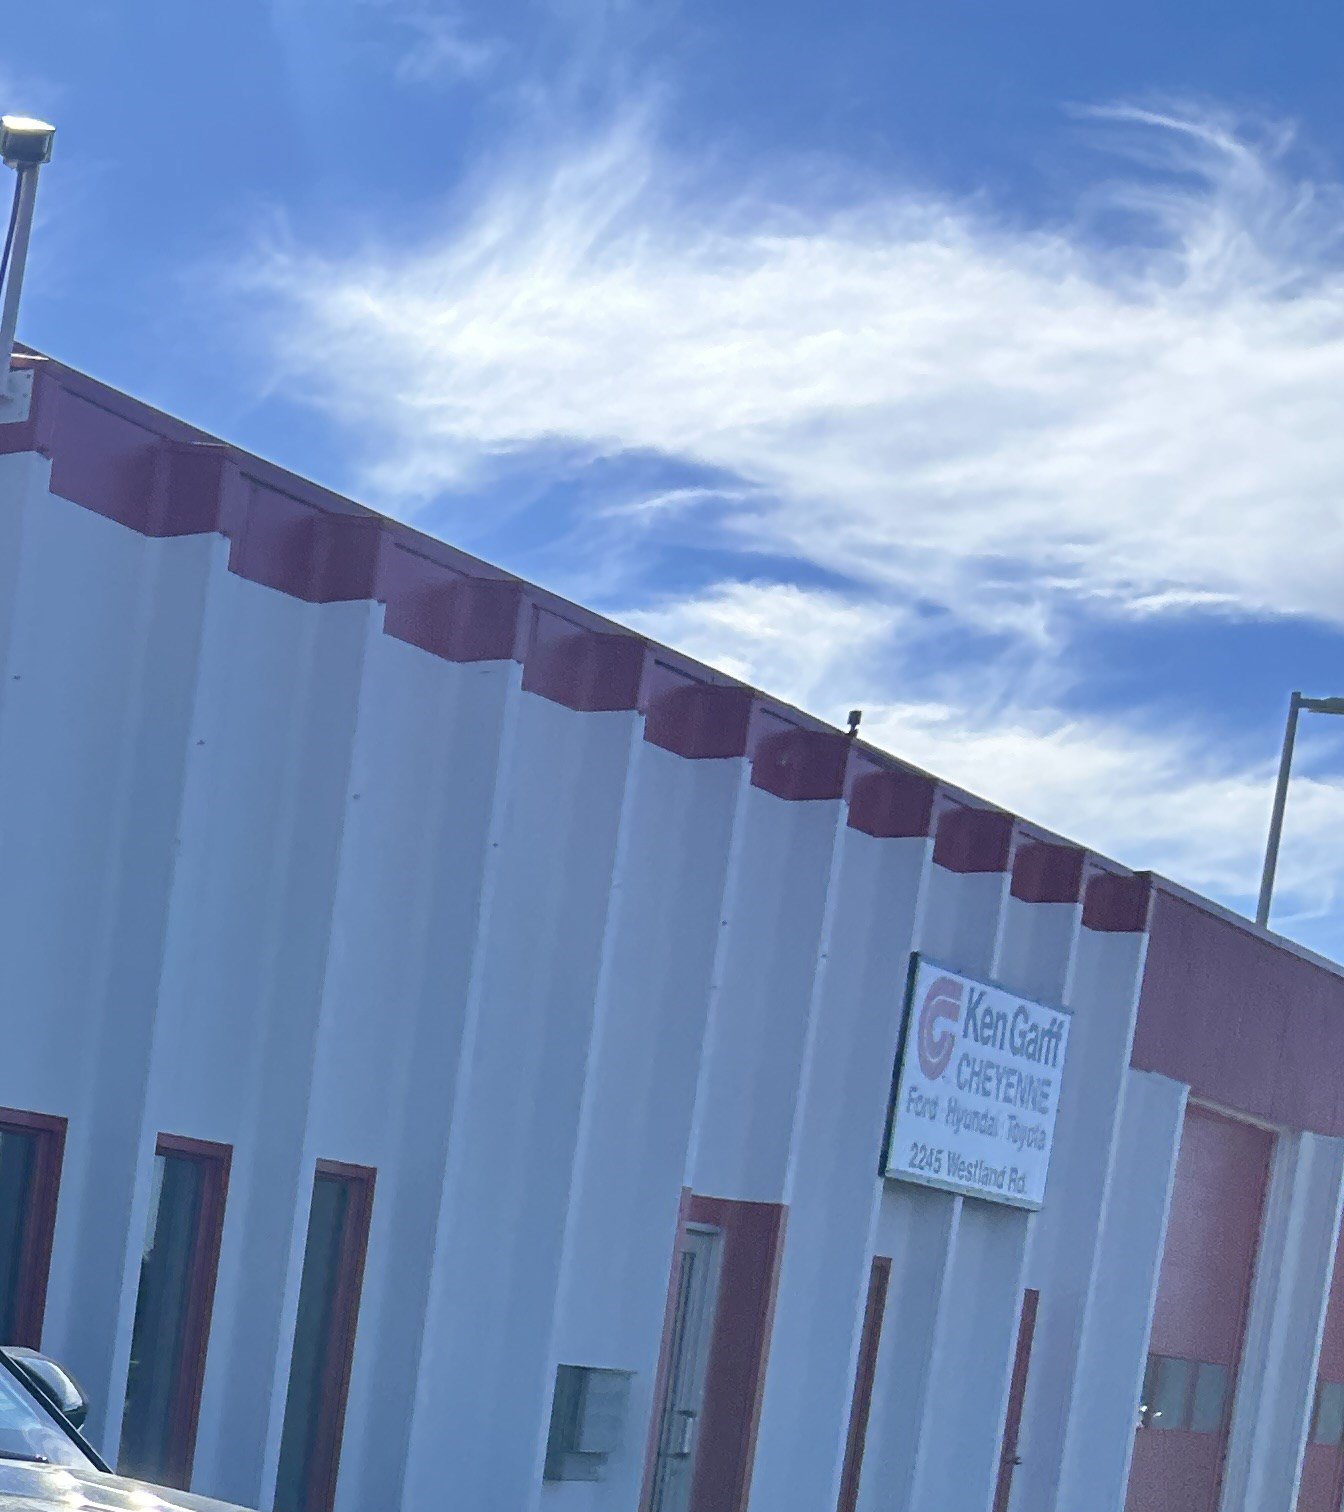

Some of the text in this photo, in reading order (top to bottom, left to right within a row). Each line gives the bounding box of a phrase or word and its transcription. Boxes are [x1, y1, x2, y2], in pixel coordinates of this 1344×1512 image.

[962, 987, 1064, 1068] Ken Garff
[956, 1053, 1052, 1115] CHEYENNE
[906, 1086, 1046, 1152] Ford Hyundai Toyota
[908, 1142, 943, 1174] 2245
[947, 1150, 1005, 1190] Westland
